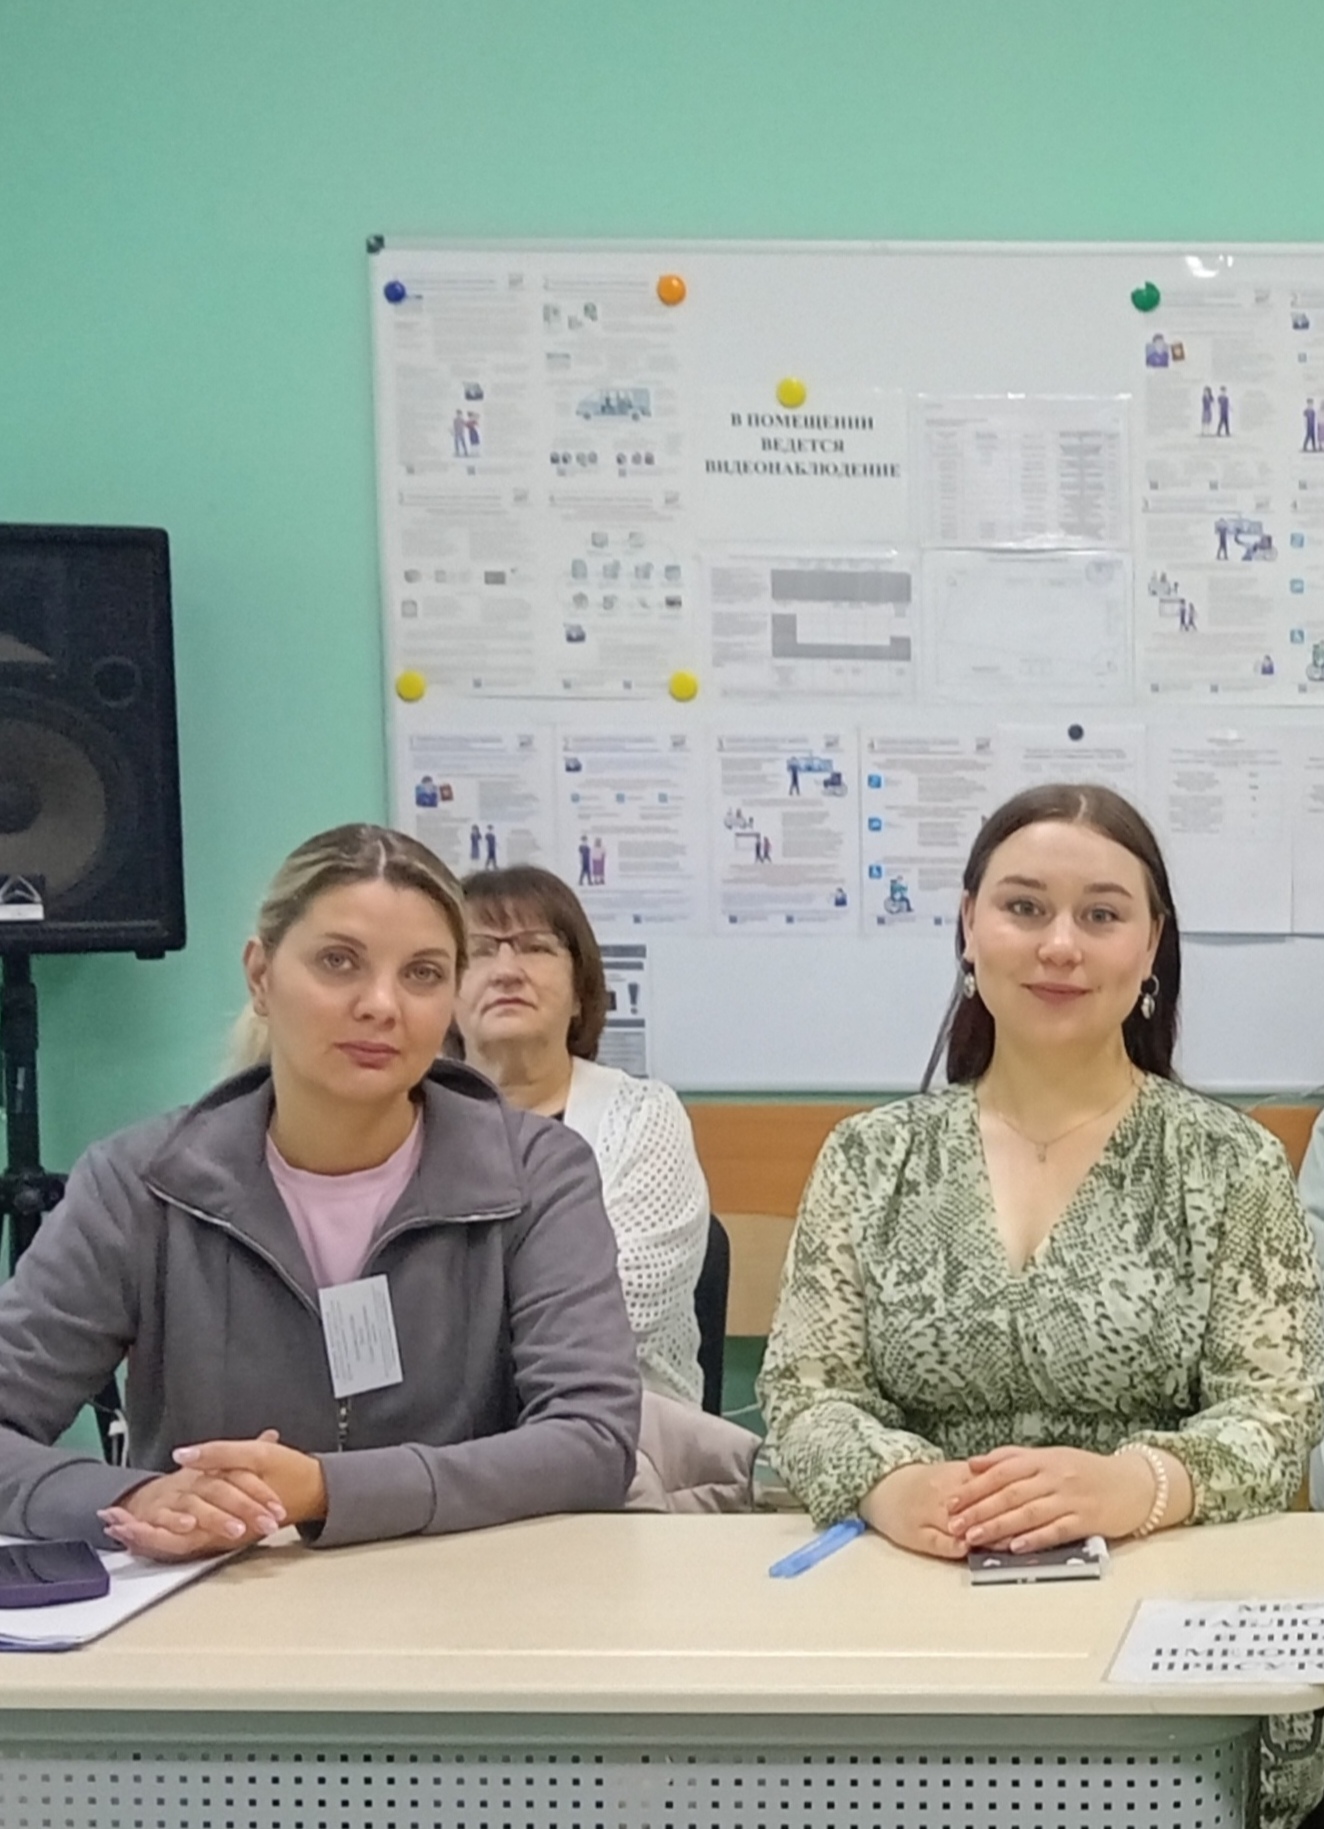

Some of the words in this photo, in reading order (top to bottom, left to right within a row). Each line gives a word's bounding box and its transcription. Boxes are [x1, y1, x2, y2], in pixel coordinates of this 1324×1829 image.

[731, 412, 743, 427] В
[747, 413, 873, 430] ПОМЕЩЕНИИ
[760, 437, 845, 453] ВЕДЕТСЯ
[705, 459, 901, 478] ВИДЕОНАБЛЮДЕНИЕ
